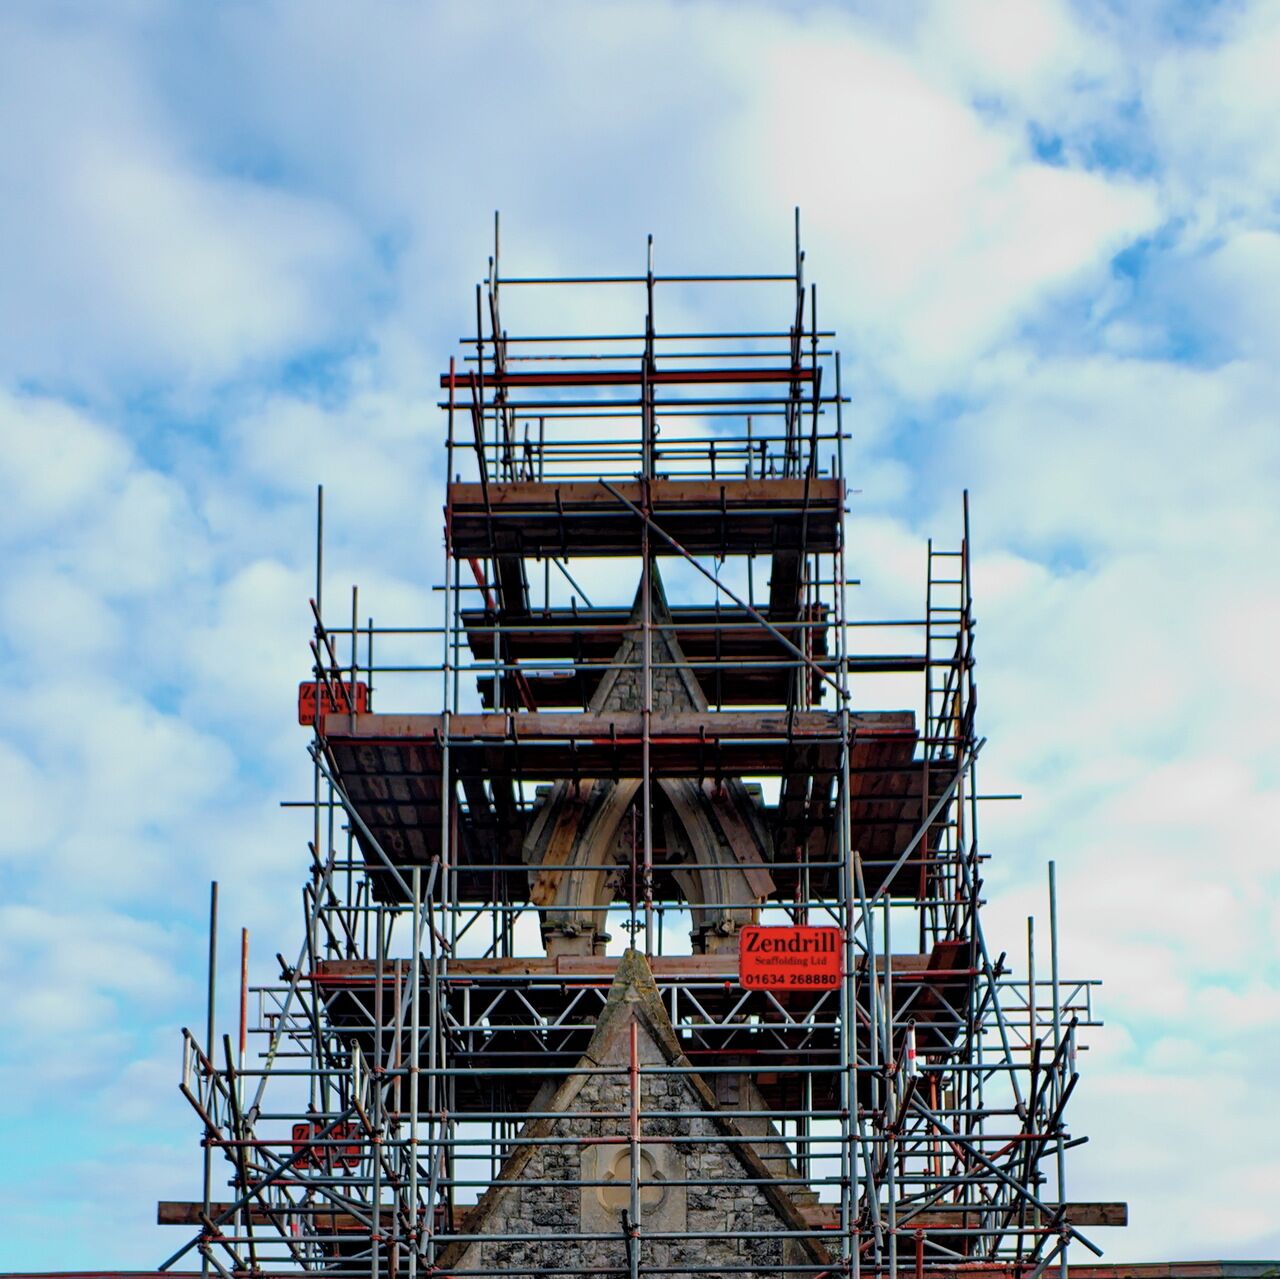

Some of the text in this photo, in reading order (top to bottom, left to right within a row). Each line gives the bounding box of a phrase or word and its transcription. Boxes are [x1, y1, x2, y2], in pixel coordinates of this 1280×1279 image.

[746, 932, 835, 953] Zendrill
[755, 956, 827, 967] Scaffolding Ltd
[746, 974, 837, 984] 01634 268880
